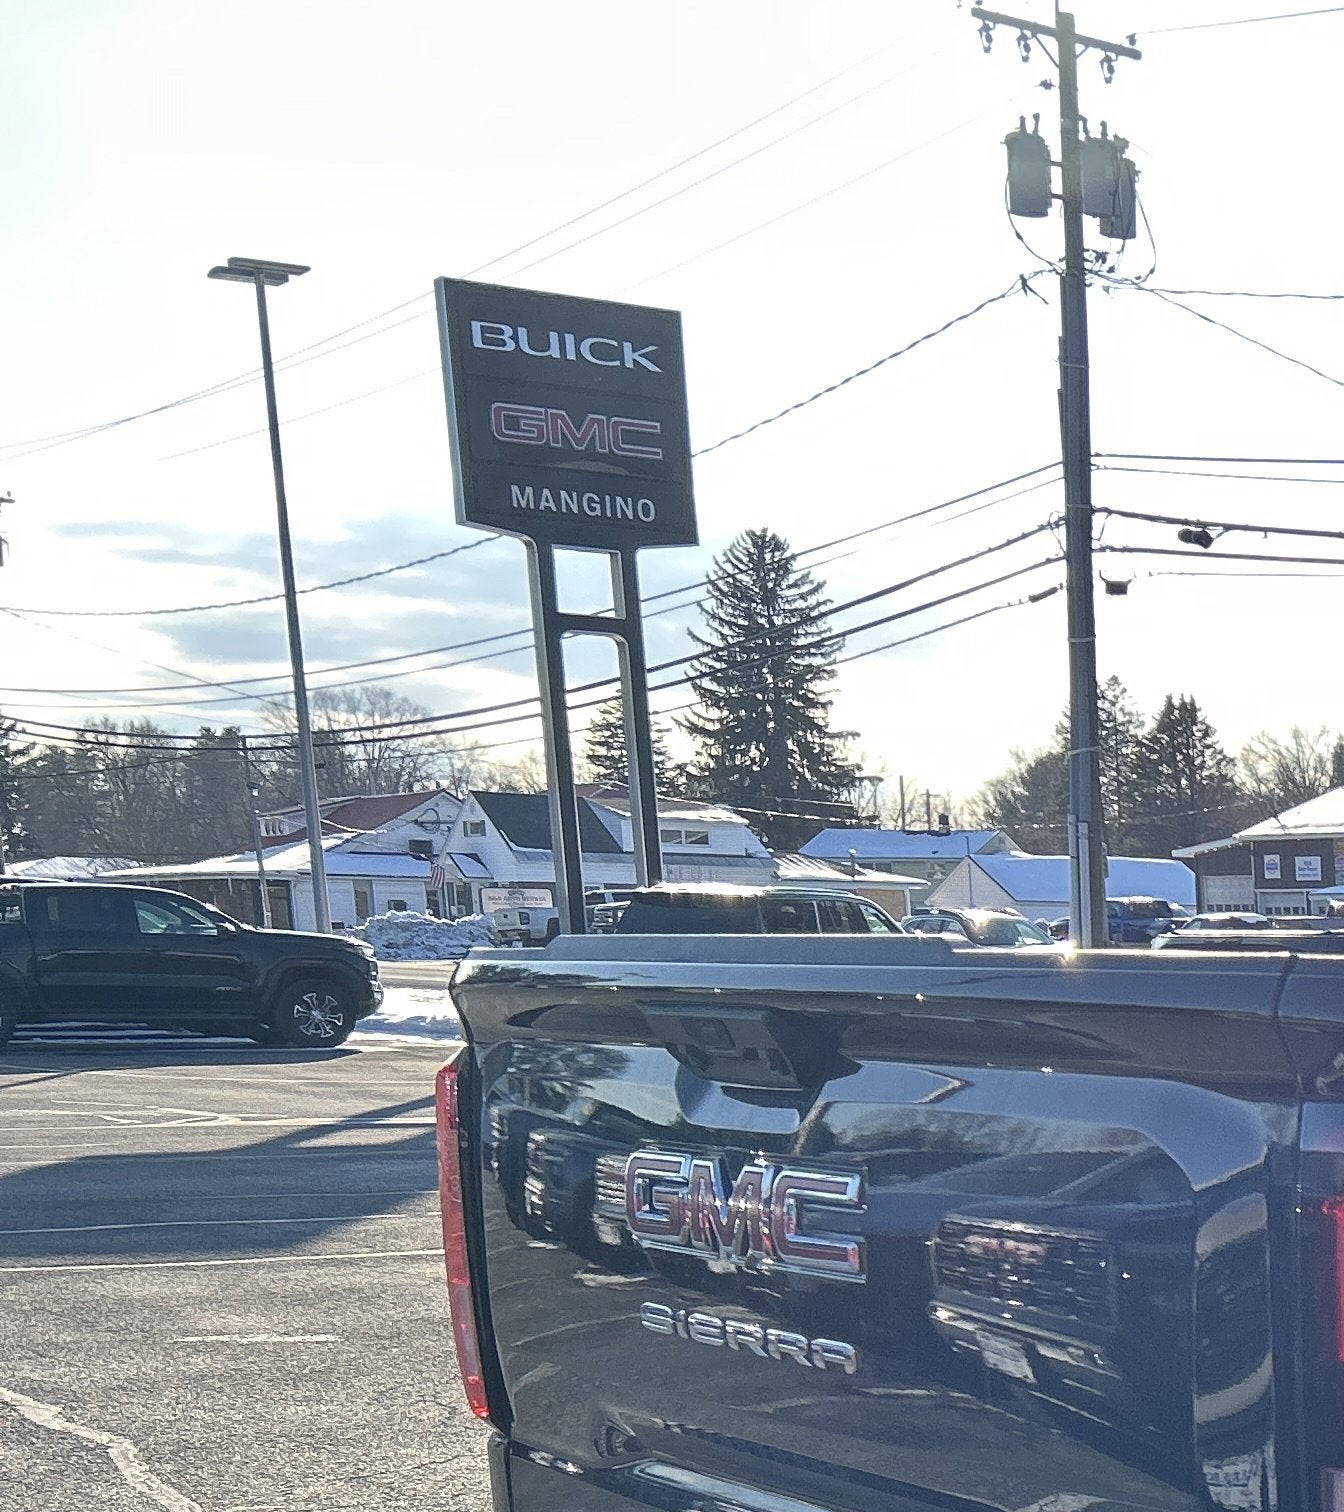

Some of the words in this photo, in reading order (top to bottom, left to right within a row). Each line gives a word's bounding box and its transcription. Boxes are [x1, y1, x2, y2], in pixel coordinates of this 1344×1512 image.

[470, 320, 663, 372] BUICK
[491, 402, 662, 460] GMC
[510, 484, 656, 523] MANGINO
[624, 1149, 865, 1275] GMC
[640, 1301, 858, 1375] SIERRA
